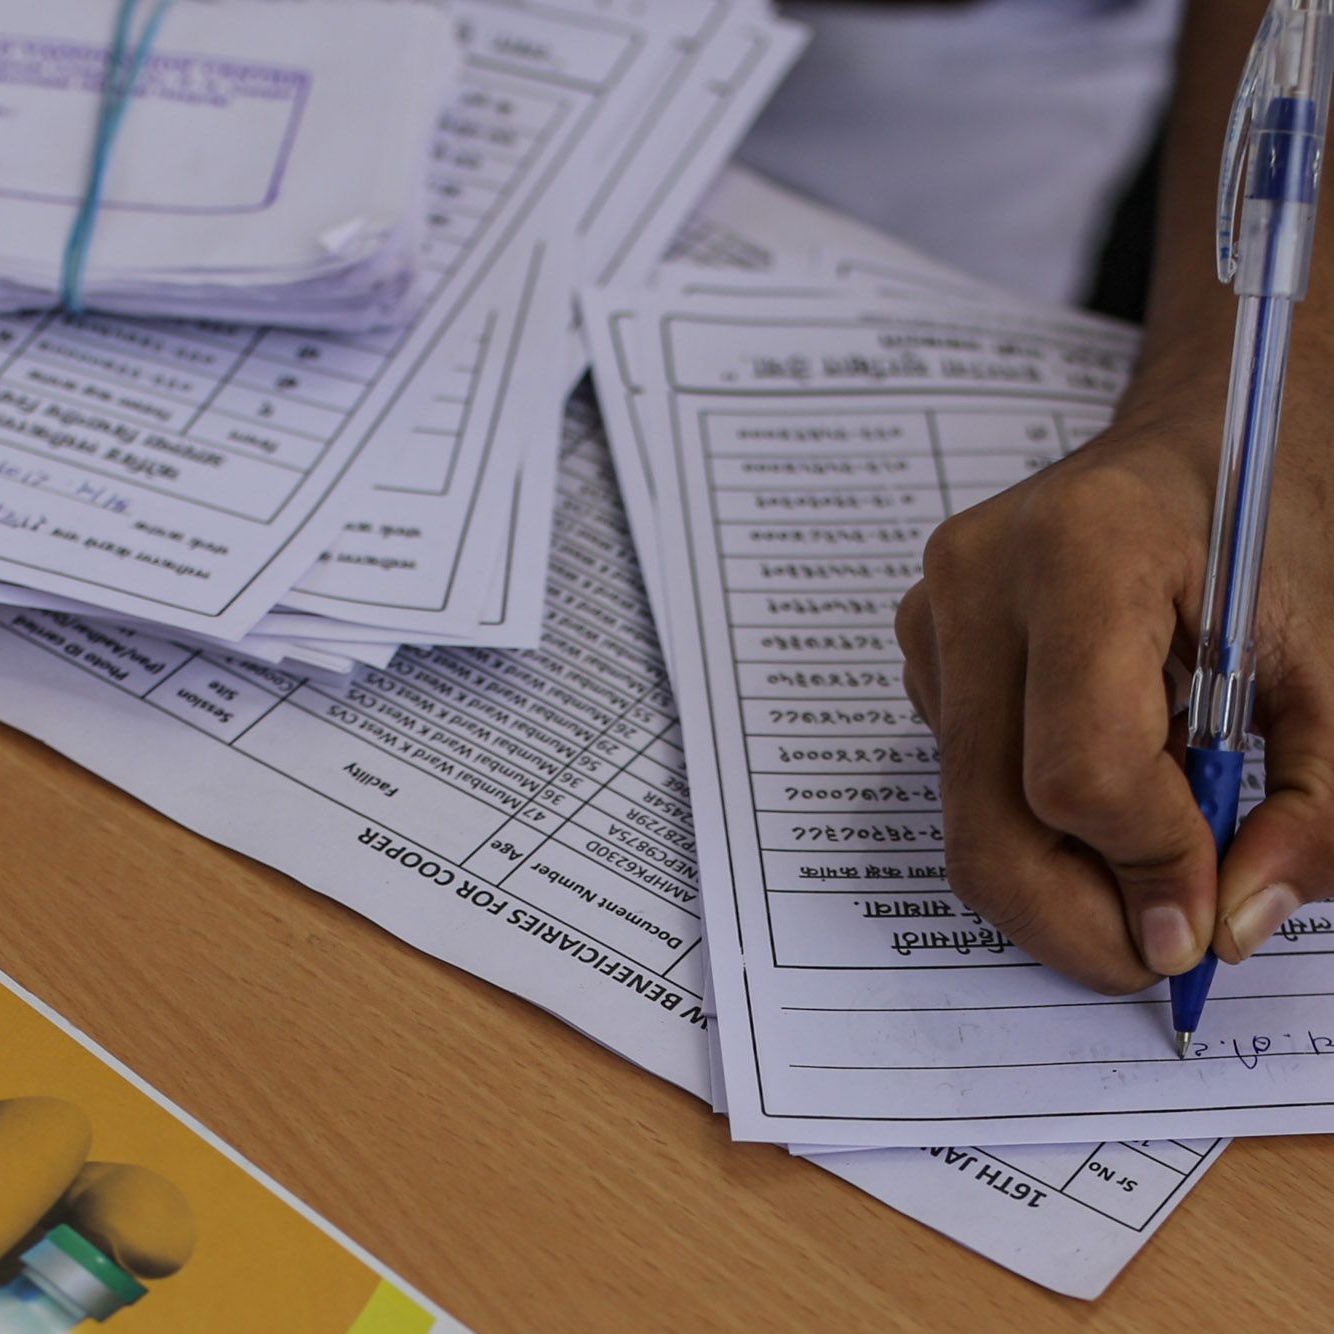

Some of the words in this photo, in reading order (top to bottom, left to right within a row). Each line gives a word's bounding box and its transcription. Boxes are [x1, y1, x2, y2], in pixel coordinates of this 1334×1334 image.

[11, 613, 66, 646] carried
[63, 643, 84, 657] ID
[83, 652, 130, 681] Photo
[176, 687, 234, 723] Session
[208, 681, 239, 701] Site
[395, 683, 430, 710] West
[326, 700, 359, 724] CVS
[376, 703, 410, 727] West
[408, 719, 426, 734] K
[441, 707, 492, 742] Ward
[358, 719, 392, 744] West
[390, 736, 408, 751] K
[422, 727, 473, 758] Ward
[405, 744, 455, 776] Ward
[492, 736, 559, 776] Mumbai
[343, 762, 399, 798] Facility
[473, 753, 541, 793] Mumbai
[559, 772, 584, 789] 36
[663, 776, 691, 799] 96E
[454, 770, 522, 810] Mumbai
[541, 789, 566, 806] 36
[522, 807, 546, 822] 47
[643, 791, 694, 828] 2454R
[626, 808, 698, 856] PZ8729R
[357, 827, 455, 886] COOPER
[490, 839, 523, 861] Age
[608, 824, 700, 884] NEPC9875A
[530, 862, 598, 903] Number
[585, 840, 701, 904] AMHPK6230D
[798, 866, 862, 882] क्रमांक
[864, 864, 905, 880] कक्ष
[455, 880, 509, 916] FOR
[853, 899, 954, 919] साधावा.
[597, 897, 684, 950] Document
[506, 909, 683, 1011] BENEFICIARIES
[974, 1164, 1048, 1208] 16TH
[1088, 1161, 1116, 1182] No
[1116, 1176, 1139, 1193] Sr
